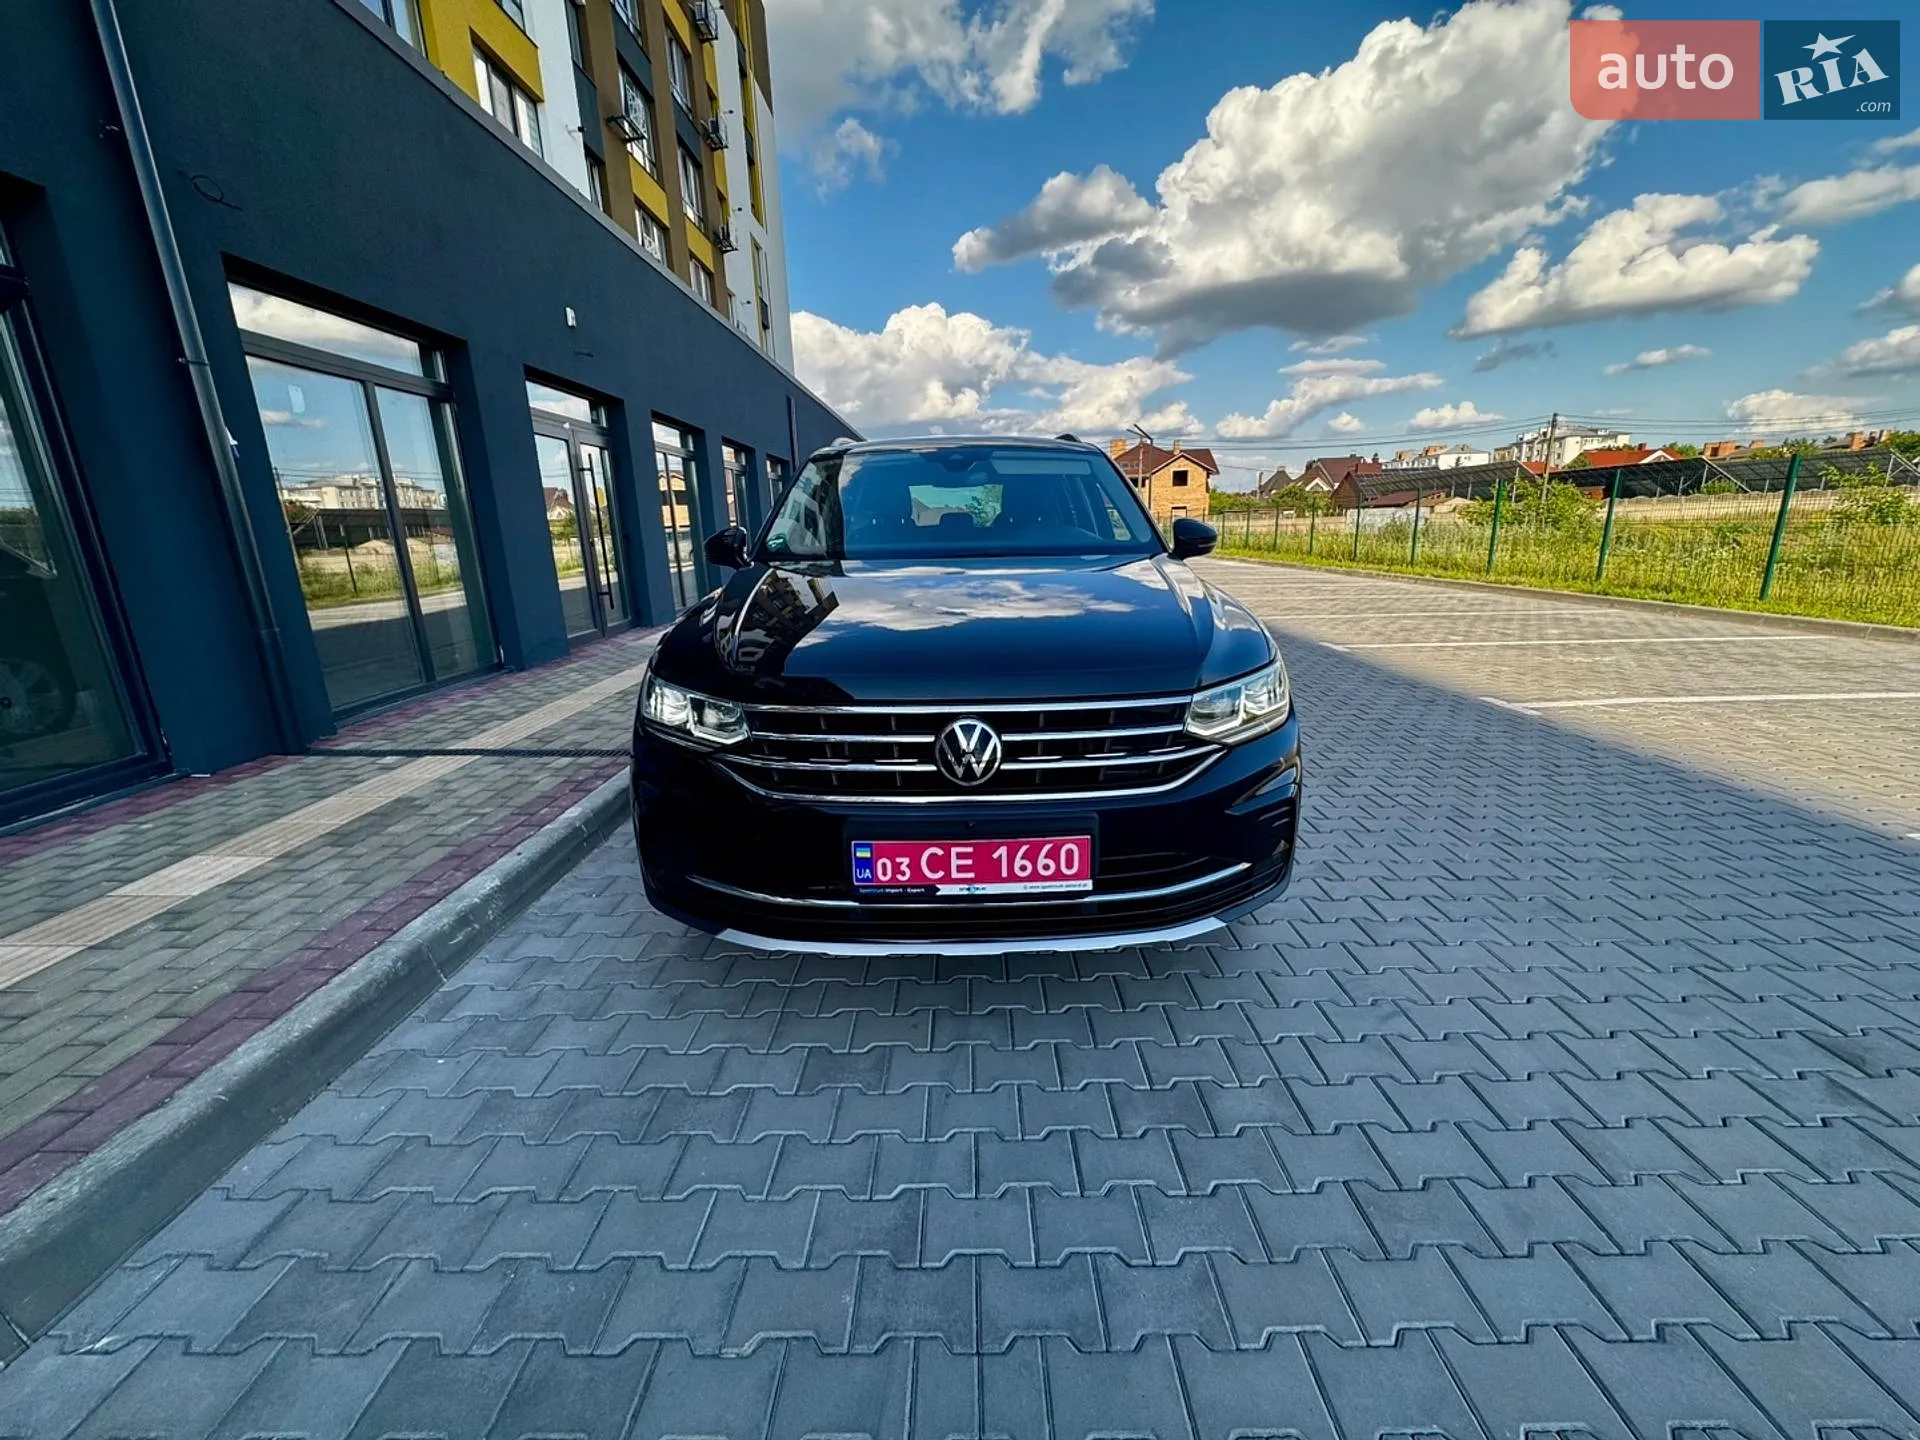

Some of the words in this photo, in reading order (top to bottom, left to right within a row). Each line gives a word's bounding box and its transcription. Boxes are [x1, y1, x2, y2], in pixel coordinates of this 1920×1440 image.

[856, 868, 872, 879] UA
[876, 857, 911, 882] 03
[920, 846, 976, 880] CE
[992, 843, 1080, 878] 1660
